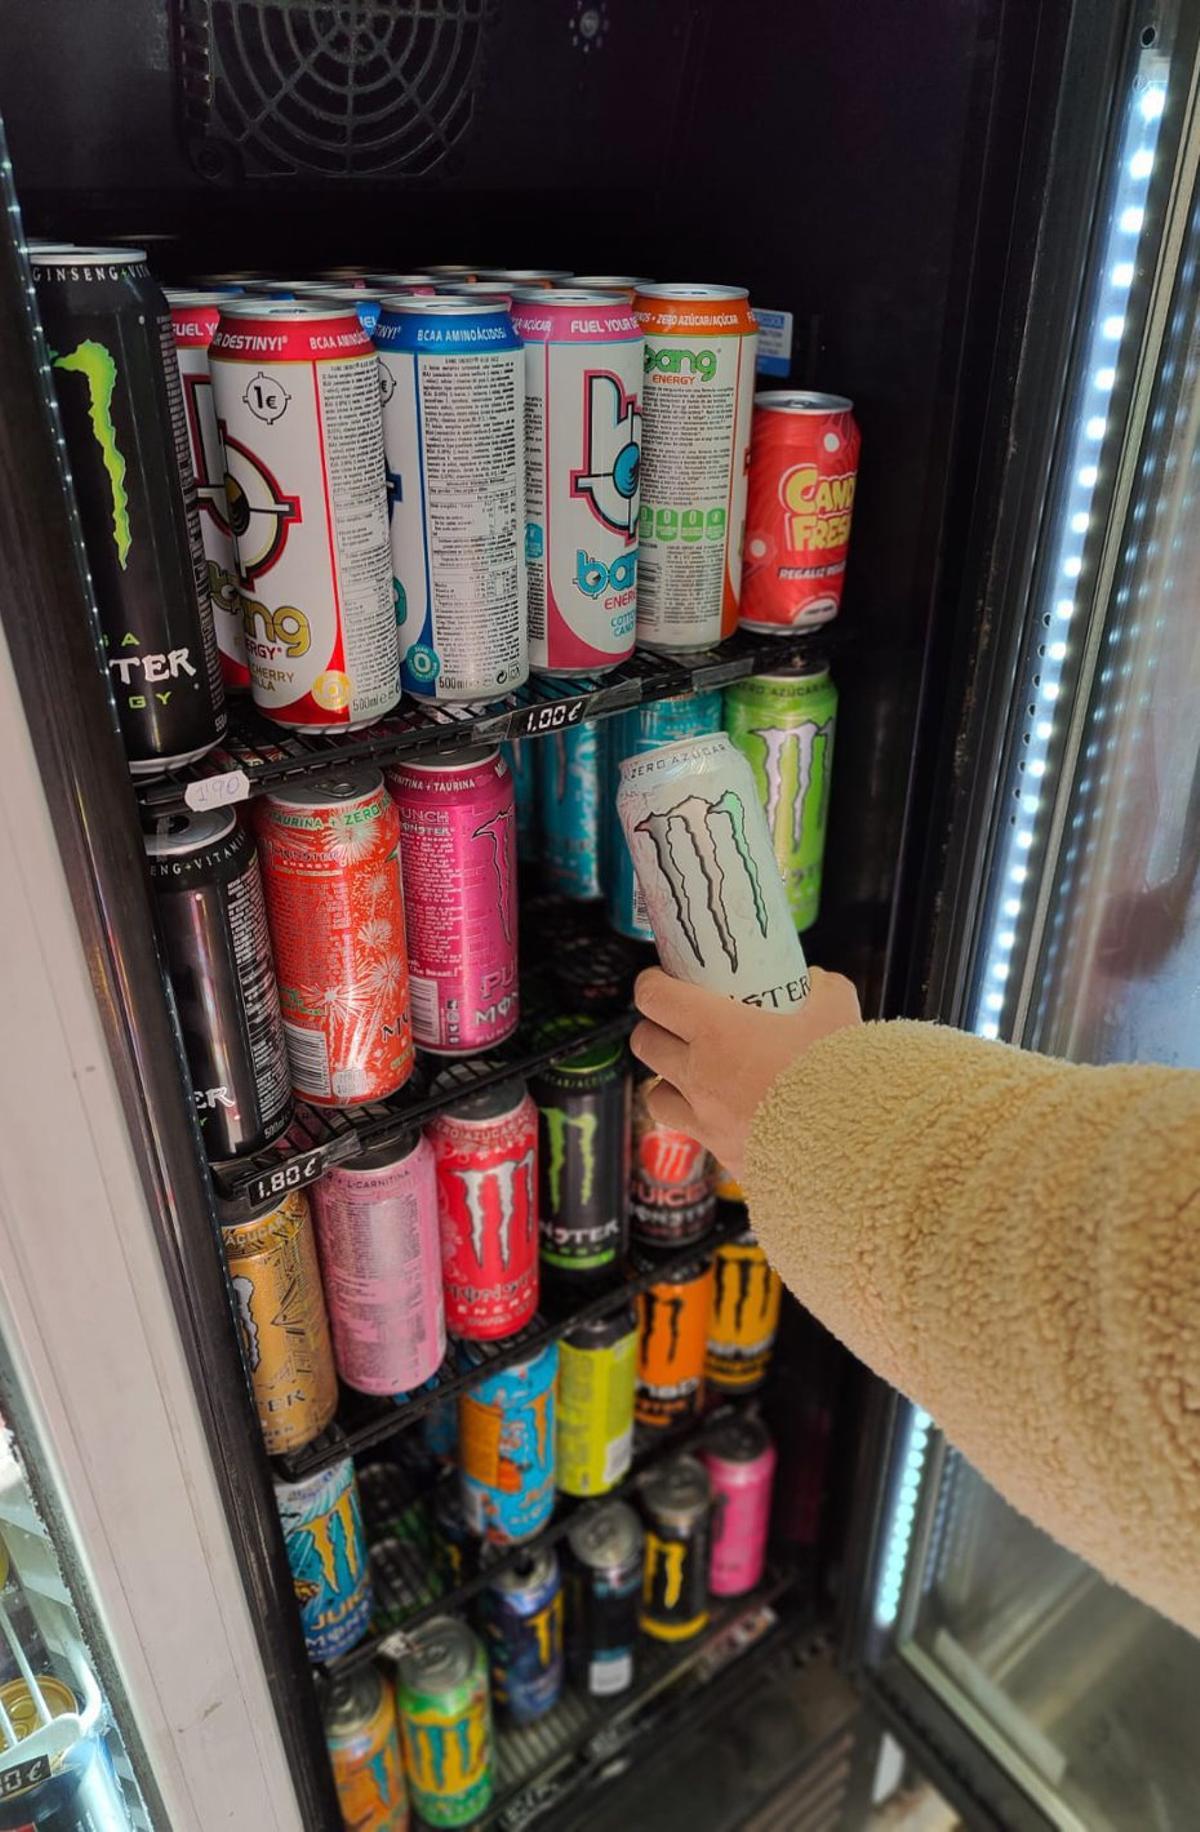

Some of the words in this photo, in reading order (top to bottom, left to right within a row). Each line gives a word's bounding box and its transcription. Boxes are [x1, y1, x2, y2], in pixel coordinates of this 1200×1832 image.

[571, 319, 603, 333] FUEL
[417, 328, 444, 342] BCAA
[652, 374, 695, 385] ENERGY
[401, 807, 450, 824] UNCH
[742, 975, 812, 1008] STER
